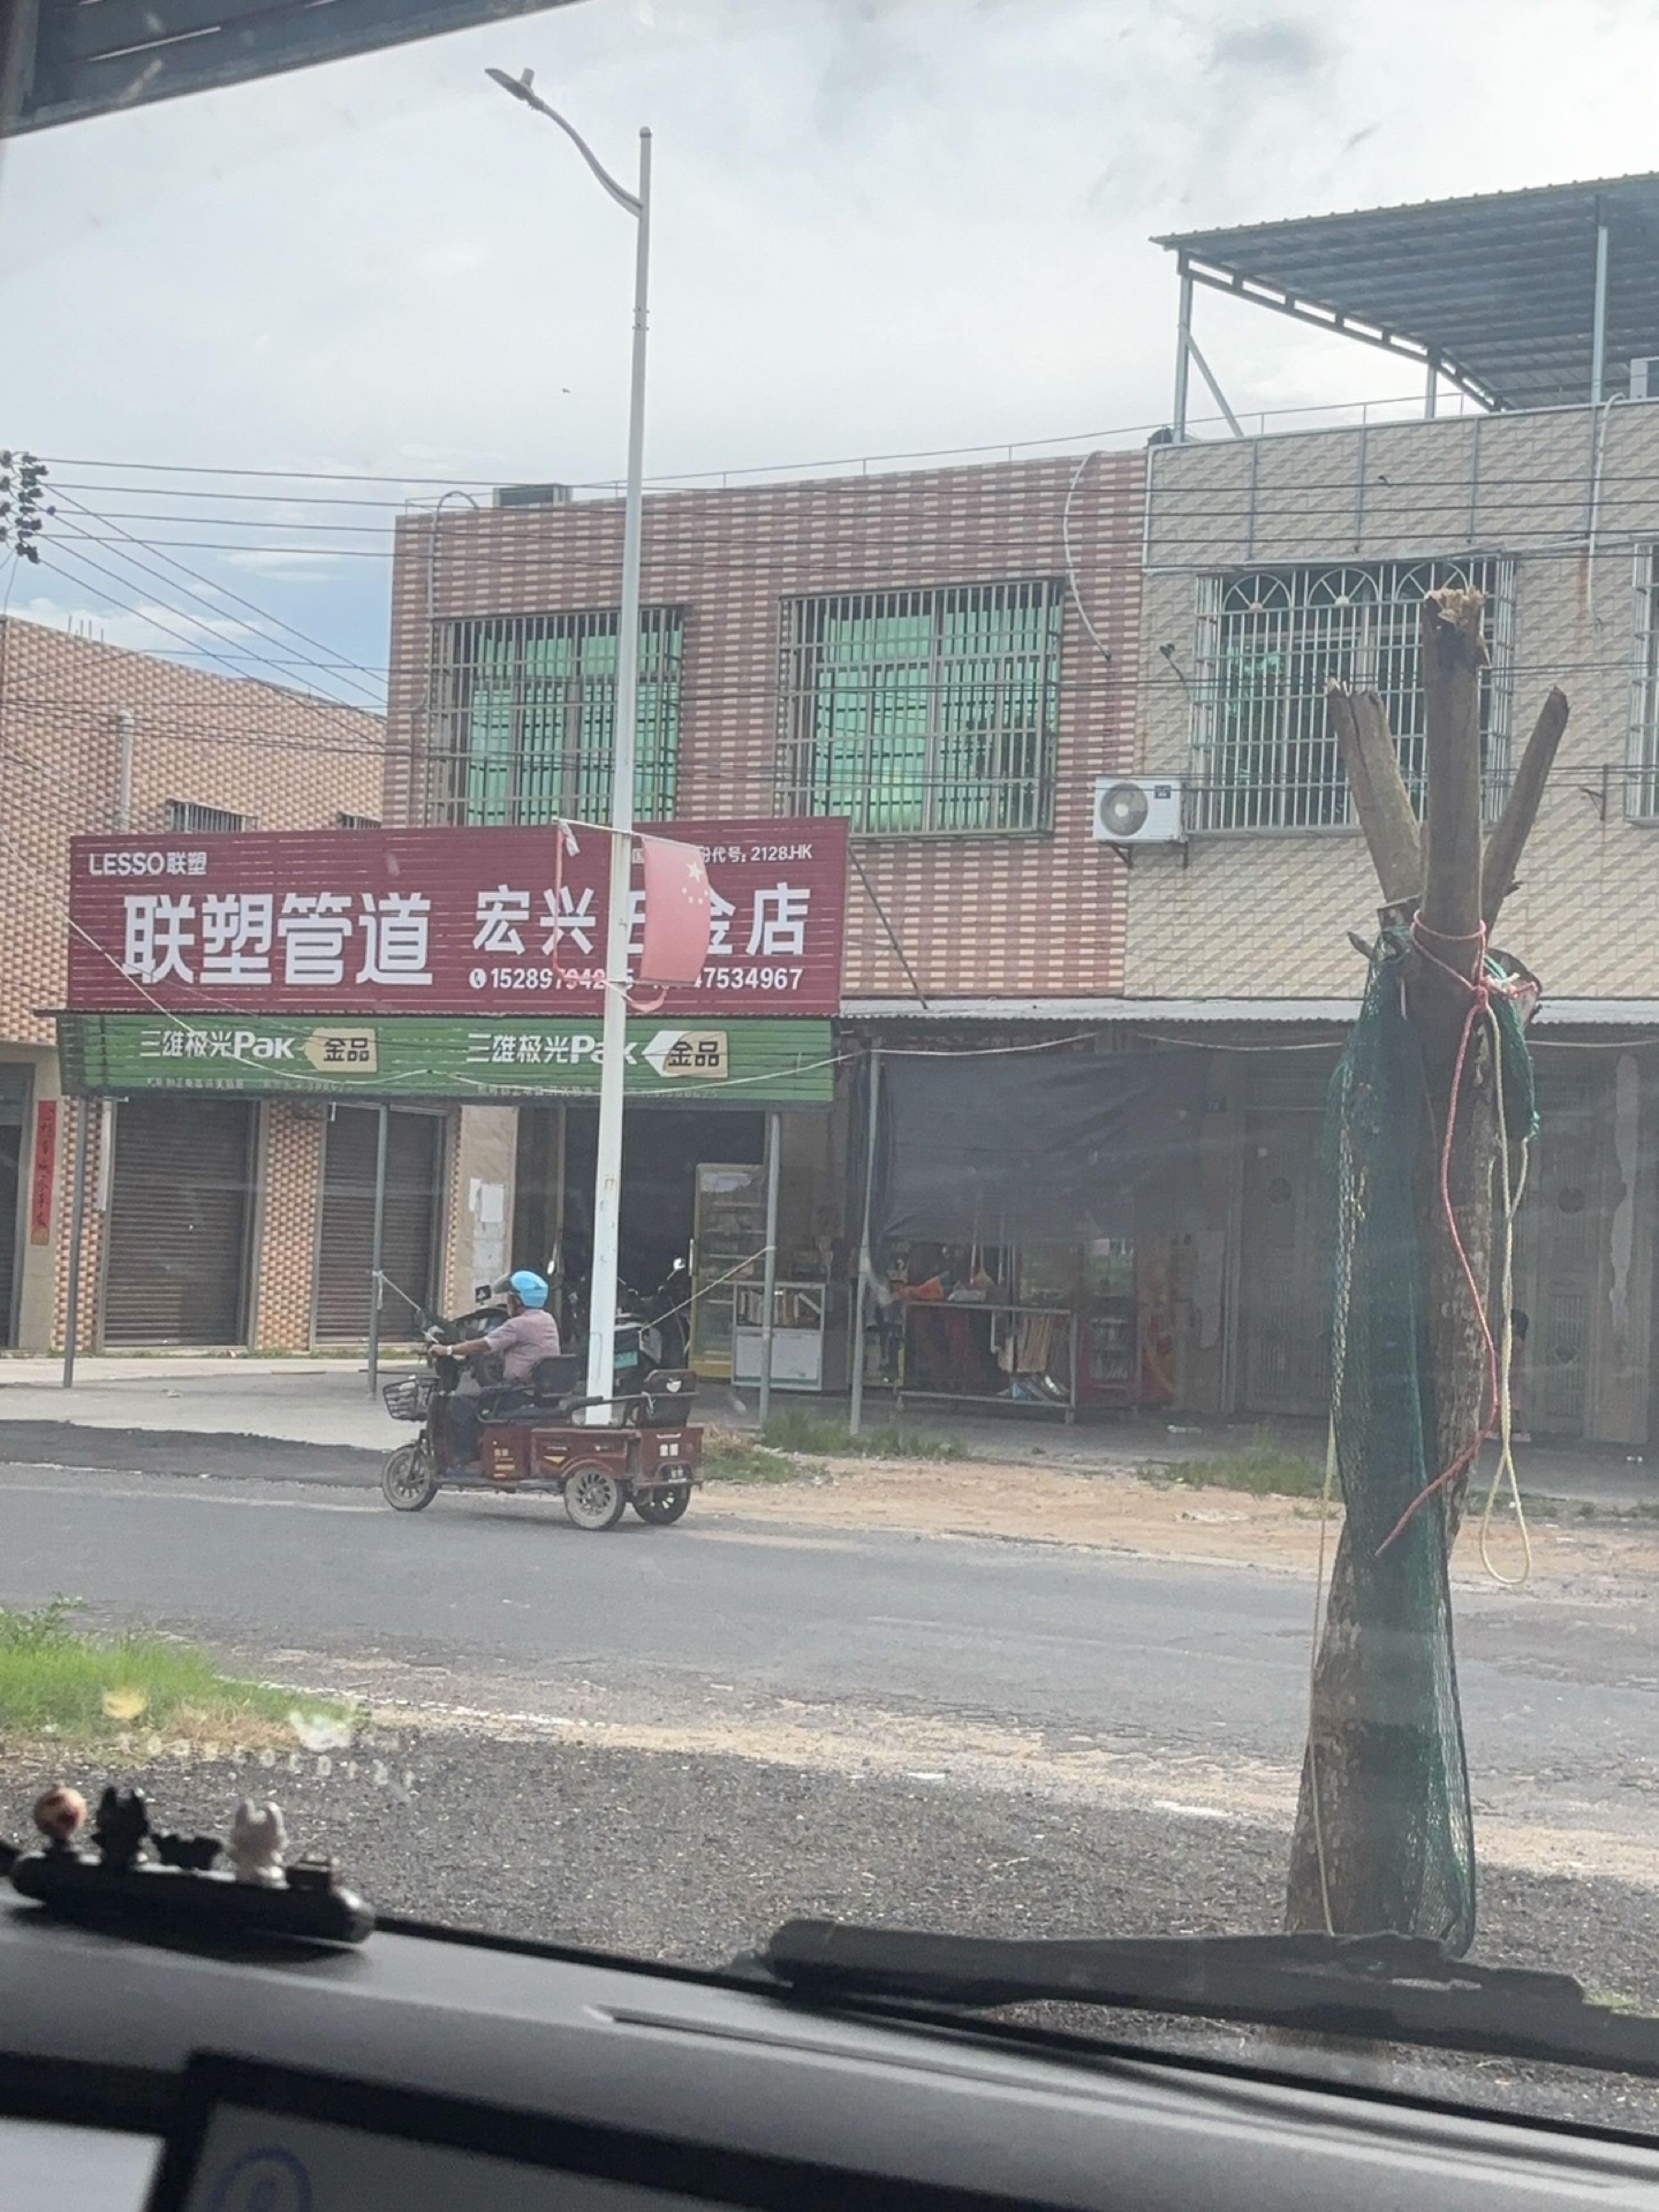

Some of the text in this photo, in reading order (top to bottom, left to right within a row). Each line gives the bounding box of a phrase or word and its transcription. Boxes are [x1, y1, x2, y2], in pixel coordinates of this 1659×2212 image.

[120, 892, 433, 986] 联塑管道
[491, 967, 803, 990] 1528979425 7534967
[323, 1037, 370, 1063] 金品
[667, 1041, 720, 1068] 金品
